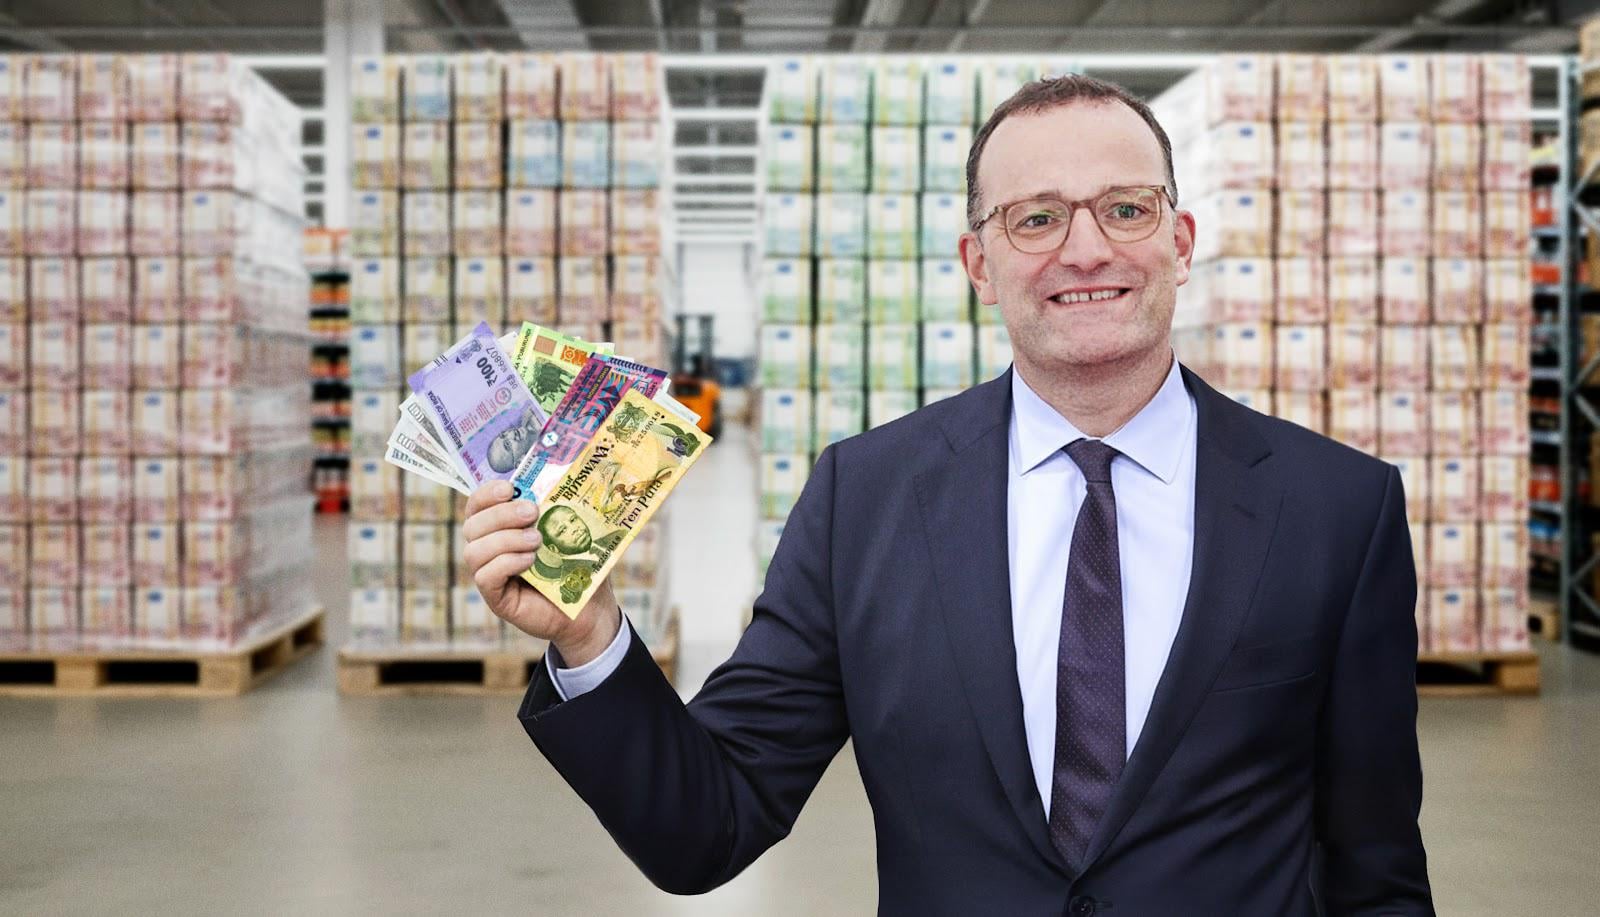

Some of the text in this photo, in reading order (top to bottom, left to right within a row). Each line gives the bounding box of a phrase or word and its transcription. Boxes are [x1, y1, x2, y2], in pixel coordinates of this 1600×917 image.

[587, 366, 609, 399] HONG KONG
[426, 390, 439, 405] INDIA
[435, 403, 443, 412] OF
[439, 411, 450, 425] BANK
[445, 423, 464, 448] RESERVE
[562, 444, 609, 500] BOTSWANA
[549, 474, 574, 503] Bank of
[618, 504, 643, 532] Ten
[636, 476, 664, 508] Pula
